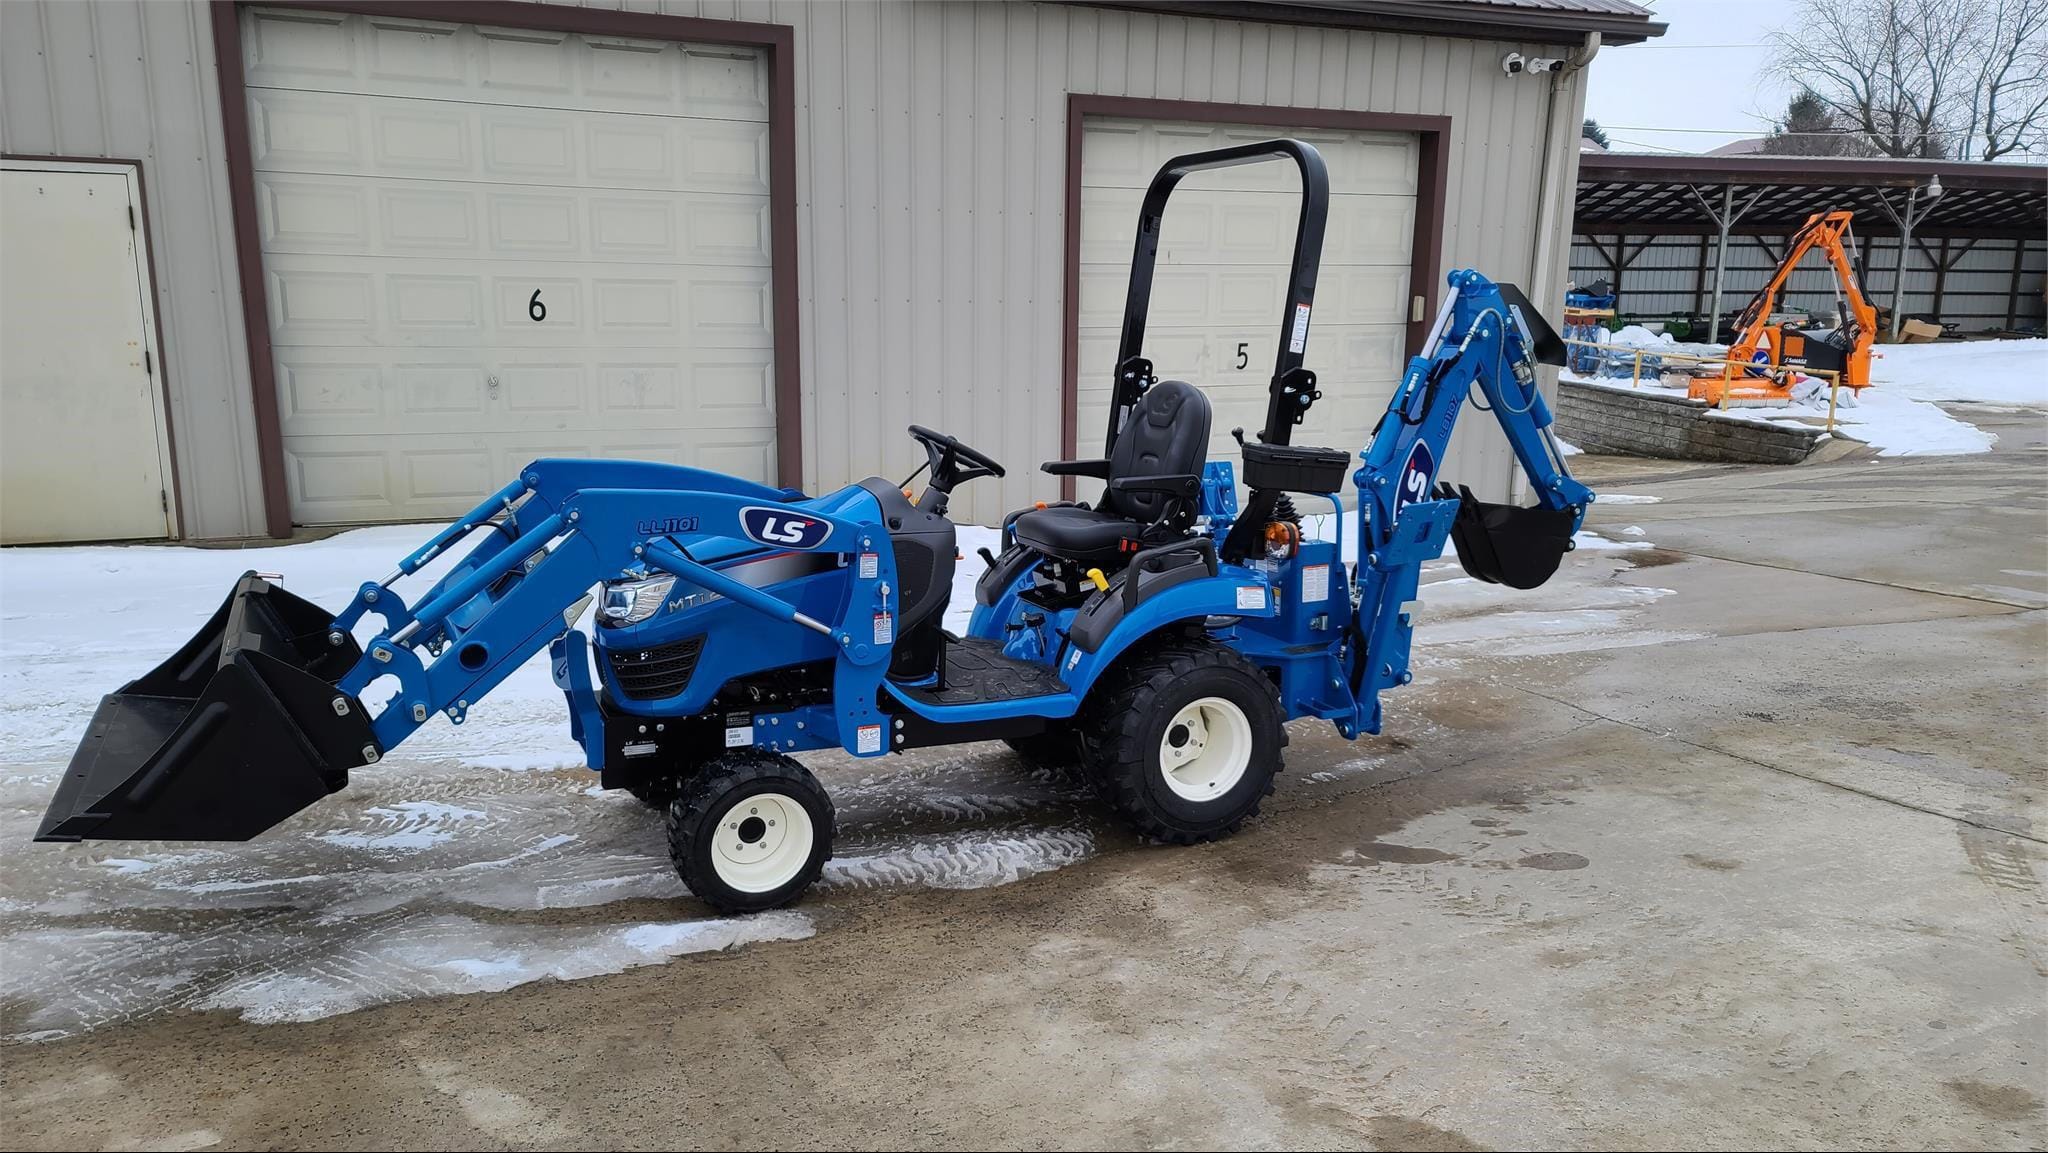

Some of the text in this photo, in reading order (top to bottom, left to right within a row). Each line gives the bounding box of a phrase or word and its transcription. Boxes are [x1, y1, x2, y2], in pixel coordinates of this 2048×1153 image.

[529, 288, 546, 321] 6
[1236, 342, 1249, 370] 5
[1401, 468, 1428, 507] S
[637, 516, 699, 535] LL1101
[762, 517, 806, 543] LS
